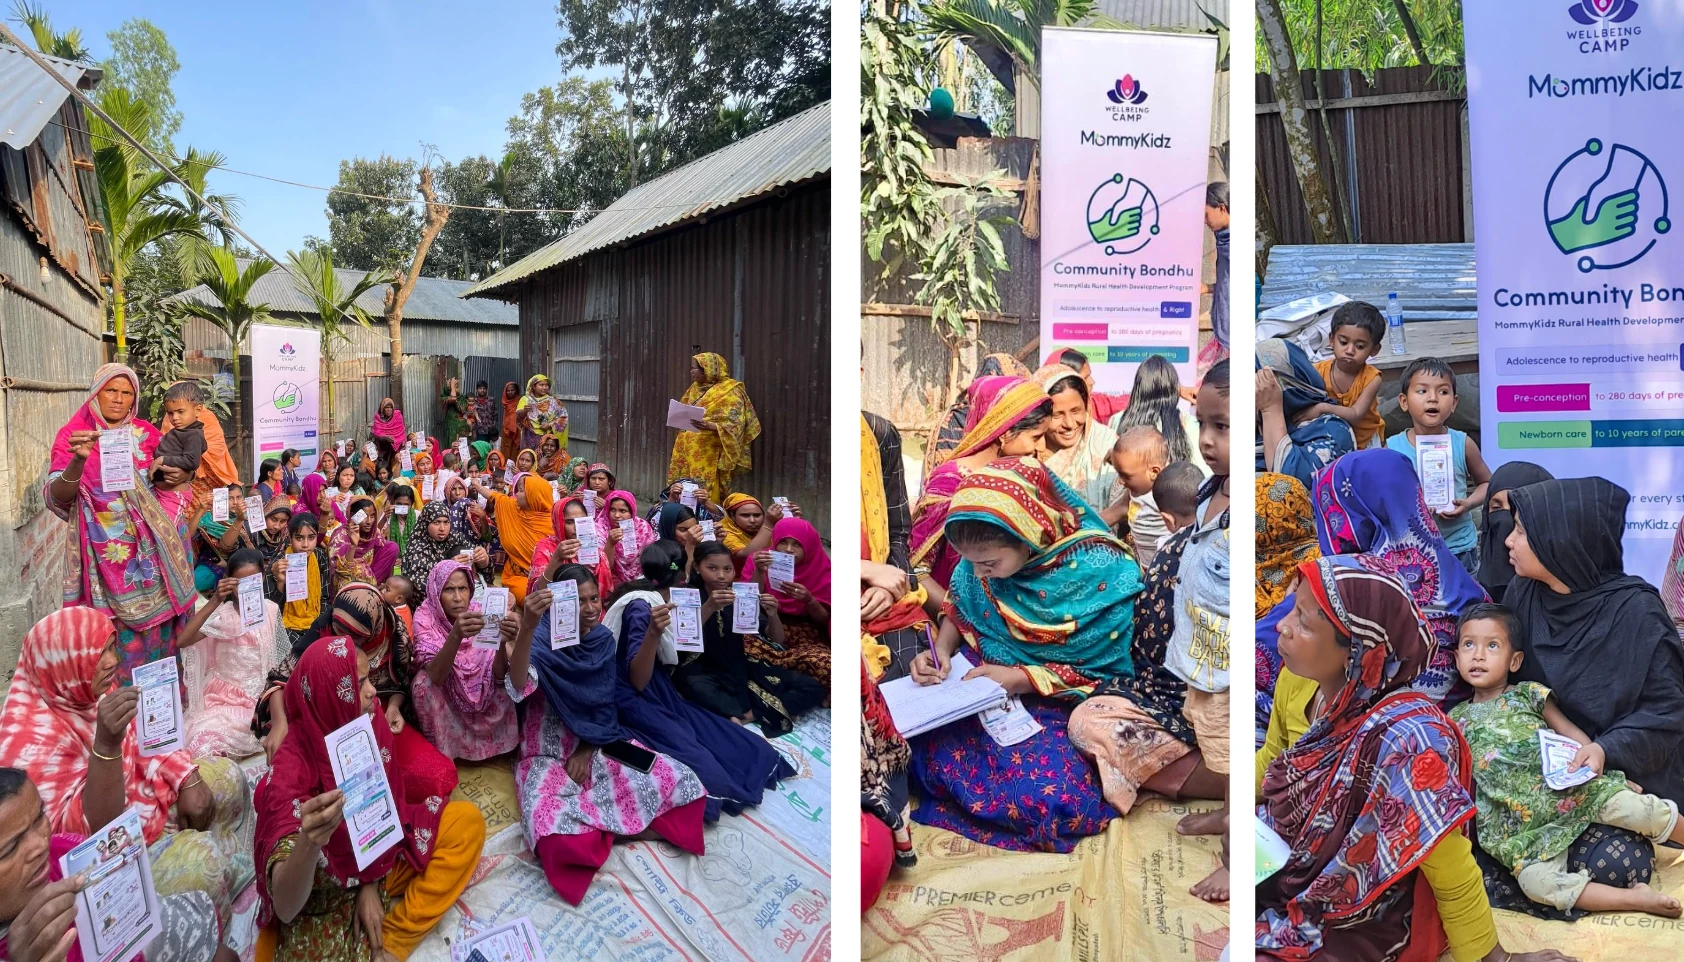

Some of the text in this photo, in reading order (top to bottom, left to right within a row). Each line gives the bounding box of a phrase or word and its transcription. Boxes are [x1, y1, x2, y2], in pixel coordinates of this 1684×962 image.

[1567, 26, 1642, 40] WELLBEING
[1579, 38, 1630, 54] CAMP
[1529, 65, 1683, 98] MommyKidz
[1112, 113, 1142, 122] CAMP
[1080, 130, 1171, 149] MommyKidz
[1054, 262, 1194, 279] Community Bondhu
[1494, 283, 1633, 309] Community
[1495, 319, 1556, 330] MommyKidz
[1558, 318, 1585, 328] Rural
[1586, 317, 1620, 326] Health
[1506, 353, 1678, 366] Adolescence to reproductive health
[1514, 393, 1587, 404] Pre-conception
[1608, 392, 1626, 400] 280
[1628, 392, 1652, 401] days
[1654, 390, 1664, 399] of
[1519, 430, 1563, 438] Newborn
[1608, 429, 1619, 438] 10
[1622, 429, 1648, 439] years
[1652, 428, 1662, 436] of
[1640, 495, 1672, 506] every
[913, 886, 996, 907] PREMIER
